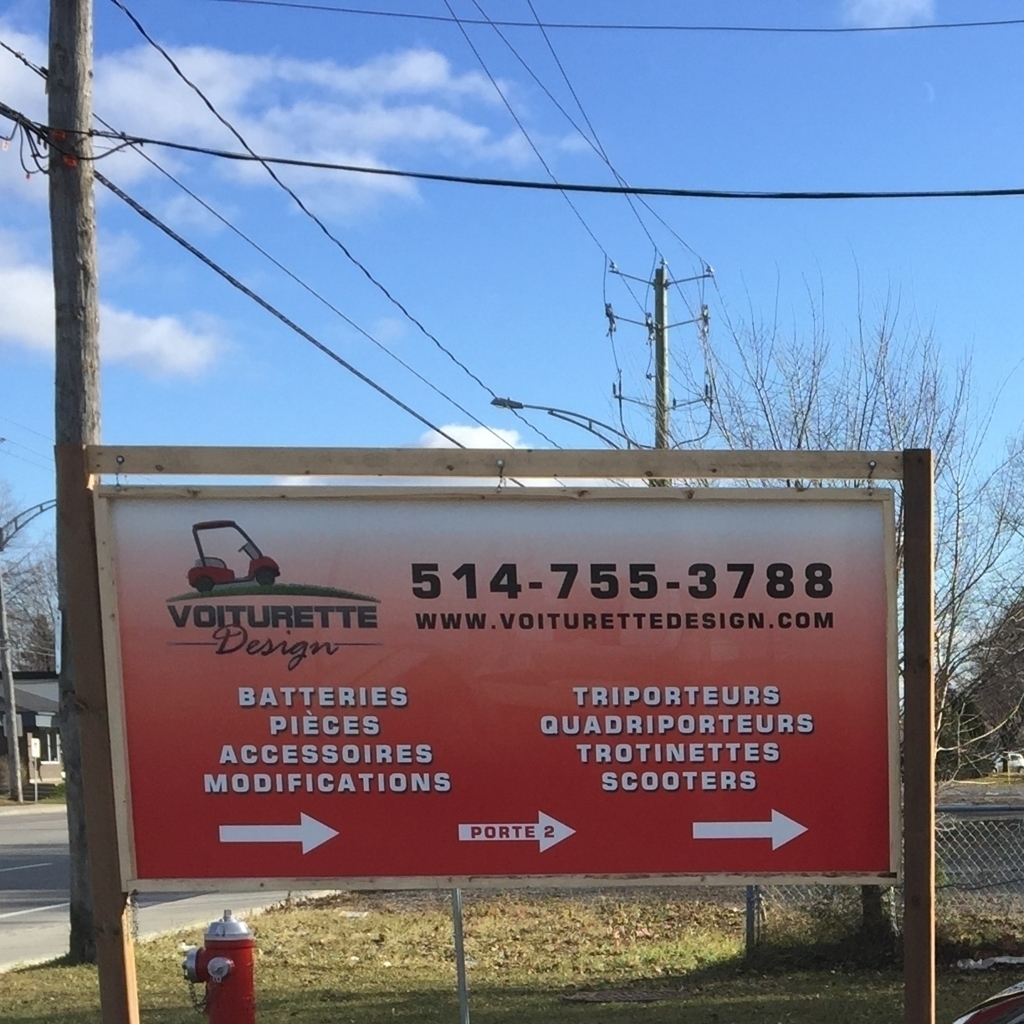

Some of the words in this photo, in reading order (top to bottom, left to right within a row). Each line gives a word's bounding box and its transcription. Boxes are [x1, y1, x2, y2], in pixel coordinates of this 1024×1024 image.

[411, 562, 834, 600] 514-755-3788
[167, 605, 378, 628] VOITURETTE
[415, 612, 834, 630] WWW.VOITURETTEDESIGN.COM
[212, 624, 339, 670] Design
[238, 686, 408, 706] BATTERIES
[573, 686, 781, 706] TRIPORTEURS
[270, 710, 380, 735] PIÈCES
[540, 715, 814, 735] QUADRIPORTEURS
[219, 745, 433, 764] ACCESSOIRES
[576, 743, 780, 763] TROTINETTES
[203, 773, 451, 792] MODIFICATIONS
[601, 772, 757, 792] SCOOTERS
[470, 826, 535, 839] PORTE
[544, 825, 555, 838] 2
